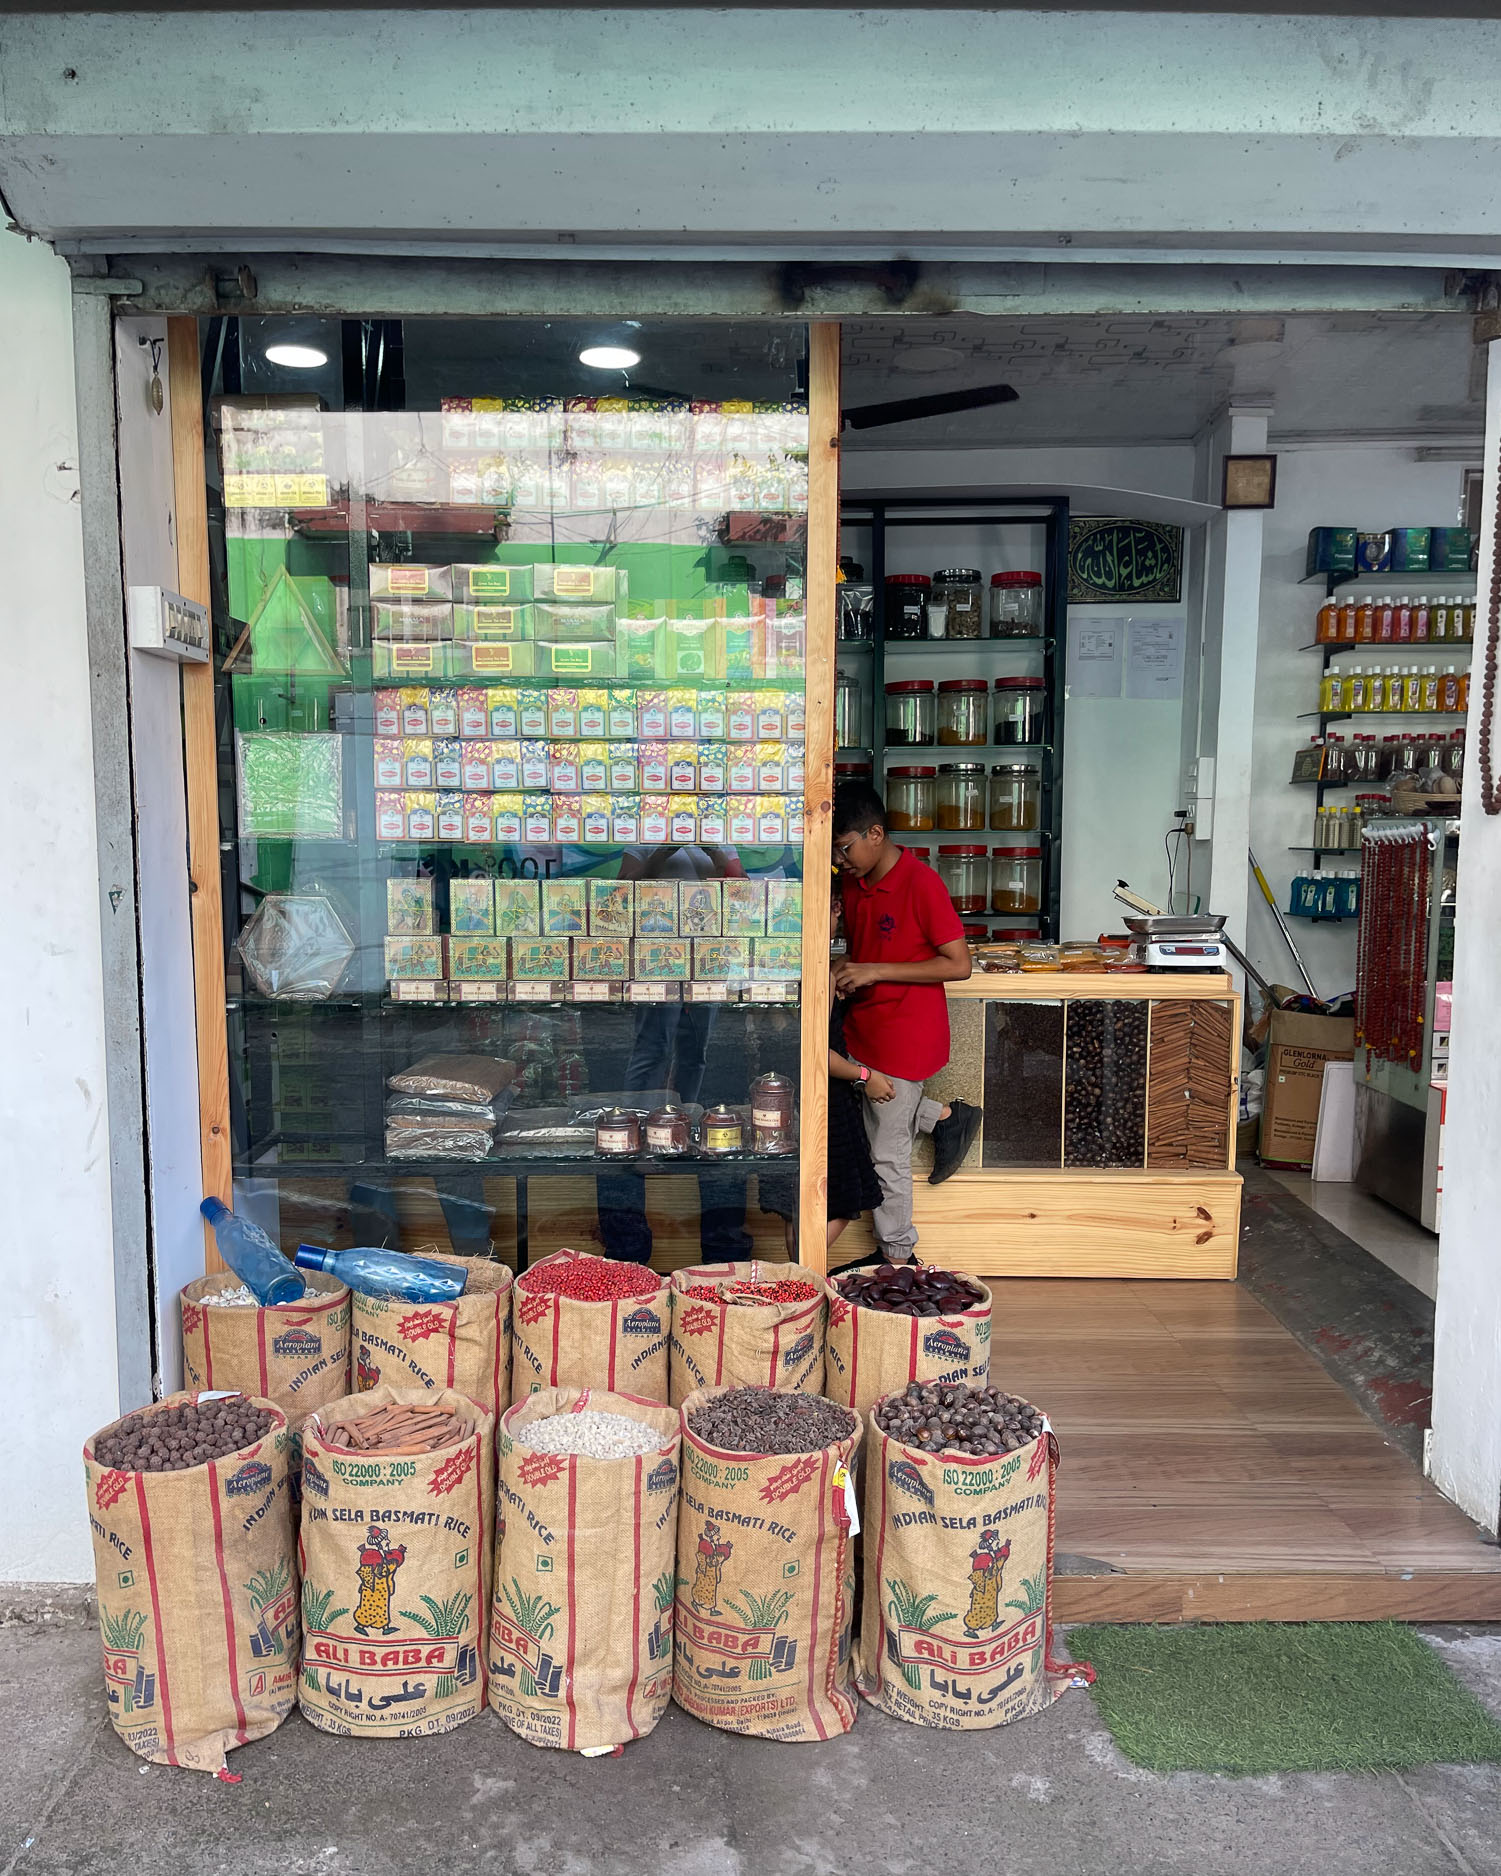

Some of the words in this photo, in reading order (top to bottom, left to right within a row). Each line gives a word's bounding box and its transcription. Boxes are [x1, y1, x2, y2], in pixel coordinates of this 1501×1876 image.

[1293, 1058, 1315, 1069] Gold
[361, 1330, 407, 1363] BASMATI
[408, 1359, 436, 1390] RICE
[523, 1345, 543, 1375] RICE
[631, 1340, 664, 1371] INDIAN
[830, 1346, 846, 1375] RICE
[289, 1357, 328, 1392] INDIAN
[685, 1354, 706, 1388] RICE
[938, 1367, 968, 1384] DIAN
[332, 1459, 346, 1477] ISO
[348, 1463, 381, 1479] 22000
[389, 1461, 417, 1477] 2005
[690, 1466, 737, 1490] COMPANY
[695, 1455, 718, 1479] 22000
[724, 1466, 749, 1482] 2005
[943, 1468, 959, 1486] ISO
[961, 1469, 994, 1488] 22000
[1000, 1455, 1021, 1480] 2005
[342, 1477, 404, 1488] COMPANY
[771, 1476, 799, 1499] DOUBLE
[954, 1476, 1012, 1496] COMPANY
[243, 1489, 276, 1532] INDIAN
[332, 1508, 364, 1523] SELA
[370, 1509, 440, 1527] BASMATI
[444, 1515, 471, 1539] RICE
[892, 1511, 938, 1531] INDIAN
[940, 1515, 977, 1530] SELA
[983, 1496, 1034, 1527] BASMATI
[526, 1509, 556, 1546] RICE
[708, 1506, 766, 1530] BASMATI
[768, 1520, 797, 1544] RICE
[109, 1531, 133, 1561] RICE
[273, 1596, 295, 1622] AL
[494, 1621, 528, 1656] ABA
[676, 1606, 688, 1629] LI
[692, 1623, 761, 1653] BABA
[314, 1642, 349, 1664] ALI
[359, 1646, 446, 1668] BABA
[968, 1620, 1037, 1667] BABA
[104, 1653, 127, 1675] BA
[344, 1708, 363, 1722] RIGHT
[498, 1701, 515, 1715] PKG.
[530, 1711, 562, 1726] 09/2022
[709, 1705, 737, 1717] KUMAR
[737, 1698, 779, 1717] (EXPORTS)
[894, 1698, 917, 1720] RETAIL
[896, 1687, 925, 1713] WEIGHT
[931, 1711, 941, 1722] 35
[928, 1699, 949, 1712] COPY
[949, 1705, 973, 1718] RIGHT
[328, 1718, 337, 1731] 35
[427, 1719, 444, 1731] DT.
[445, 1706, 476, 1724] 09/2022
[516, 1719, 525, 1729] OF
[526, 1721, 538, 1733] ALL
